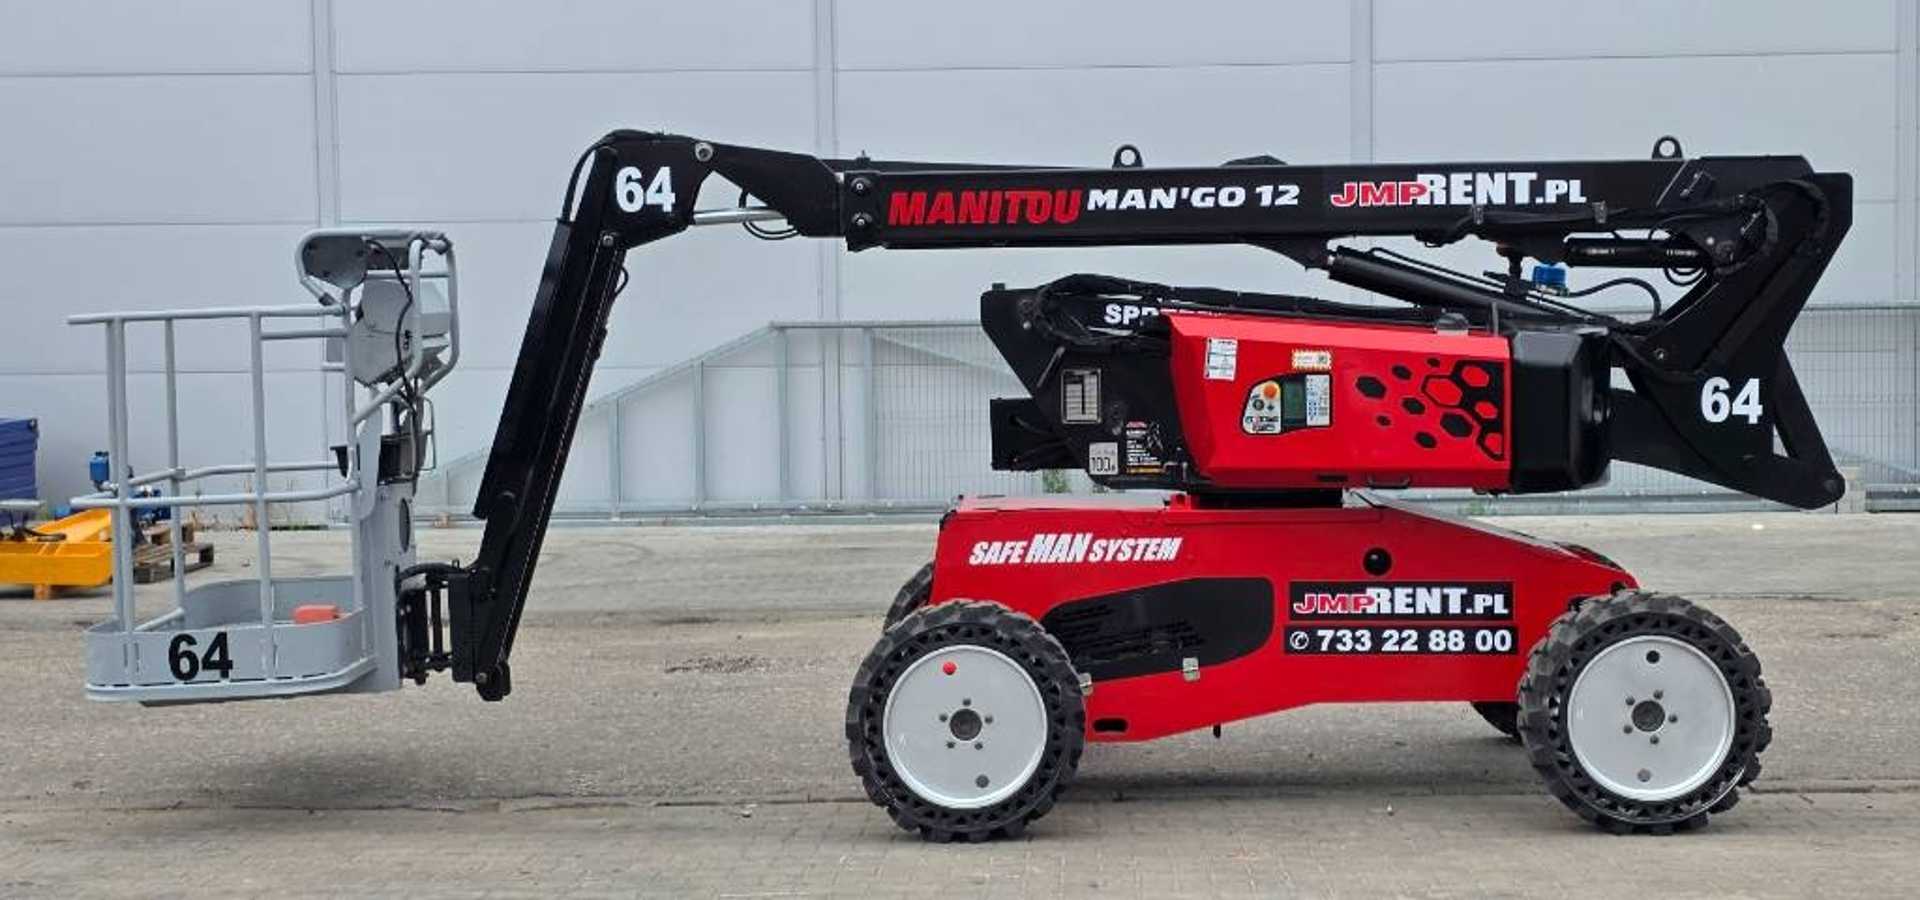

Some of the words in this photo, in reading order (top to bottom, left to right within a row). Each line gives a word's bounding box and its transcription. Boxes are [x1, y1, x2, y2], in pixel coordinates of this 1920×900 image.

[615, 166, 675, 213] 64
[888, 189, 1083, 226] MANITOU
[1087, 187, 1245, 211] MAN'GO
[1254, 184, 1299, 207] 12
[1329, 172, 1588, 207] JMPRENT.PL
[1701, 376, 1763, 424] 64
[969, 541, 1027, 565] SAFE
[1025, 533, 1093, 563] MAN
[1089, 537, 1182, 562] SYSTEM
[1293, 587, 1509, 614] JMPRENT.PL
[168, 631, 233, 681] 64
[1317, 630, 1372, 651] 733
[1381, 630, 1418, 652] 22
[1428, 630, 1465, 652] 88
[1475, 630, 1512, 652] 00
